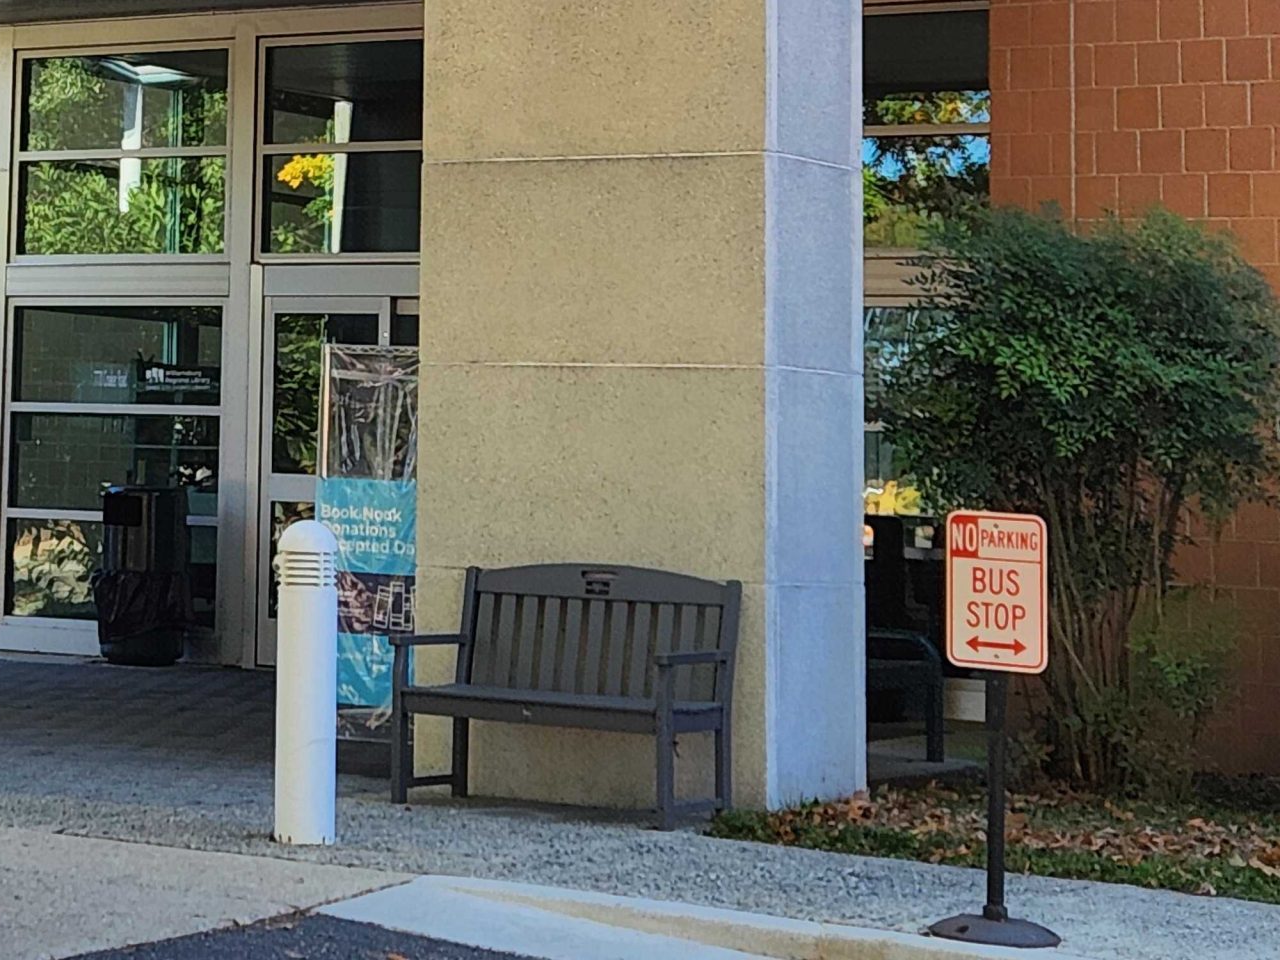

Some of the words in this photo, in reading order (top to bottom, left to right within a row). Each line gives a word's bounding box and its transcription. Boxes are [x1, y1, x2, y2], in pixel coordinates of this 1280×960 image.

[320, 503, 360, 519] Book
[362, 506, 402, 522] Nook
[338, 538, 390, 555] cepted
[952, 522, 978, 552] NO
[980, 529, 1038, 551] PARKING
[972, 566, 1020, 597] BUS
[966, 601, 1026, 632] STOP
